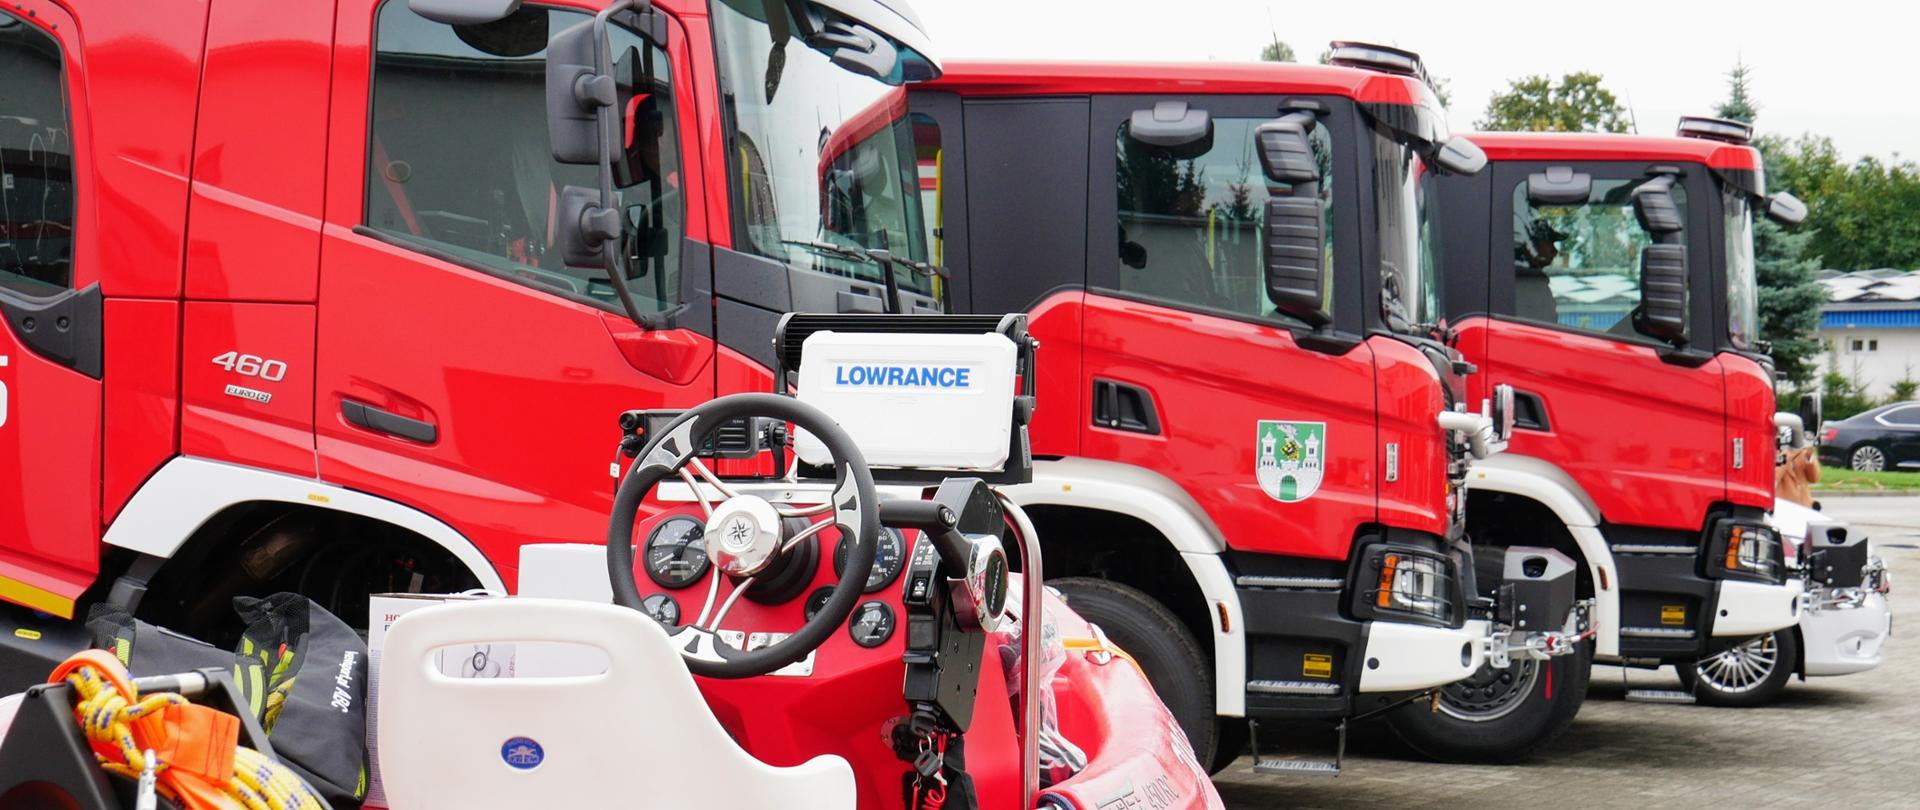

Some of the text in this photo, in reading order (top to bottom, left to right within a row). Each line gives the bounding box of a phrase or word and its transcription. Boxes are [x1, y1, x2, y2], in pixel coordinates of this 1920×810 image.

[212, 351, 287, 381] 460
[836, 366, 970, 387] LOWRANCE
[227, 386, 256, 399] EURO
[331, 686, 352, 713] ABC
